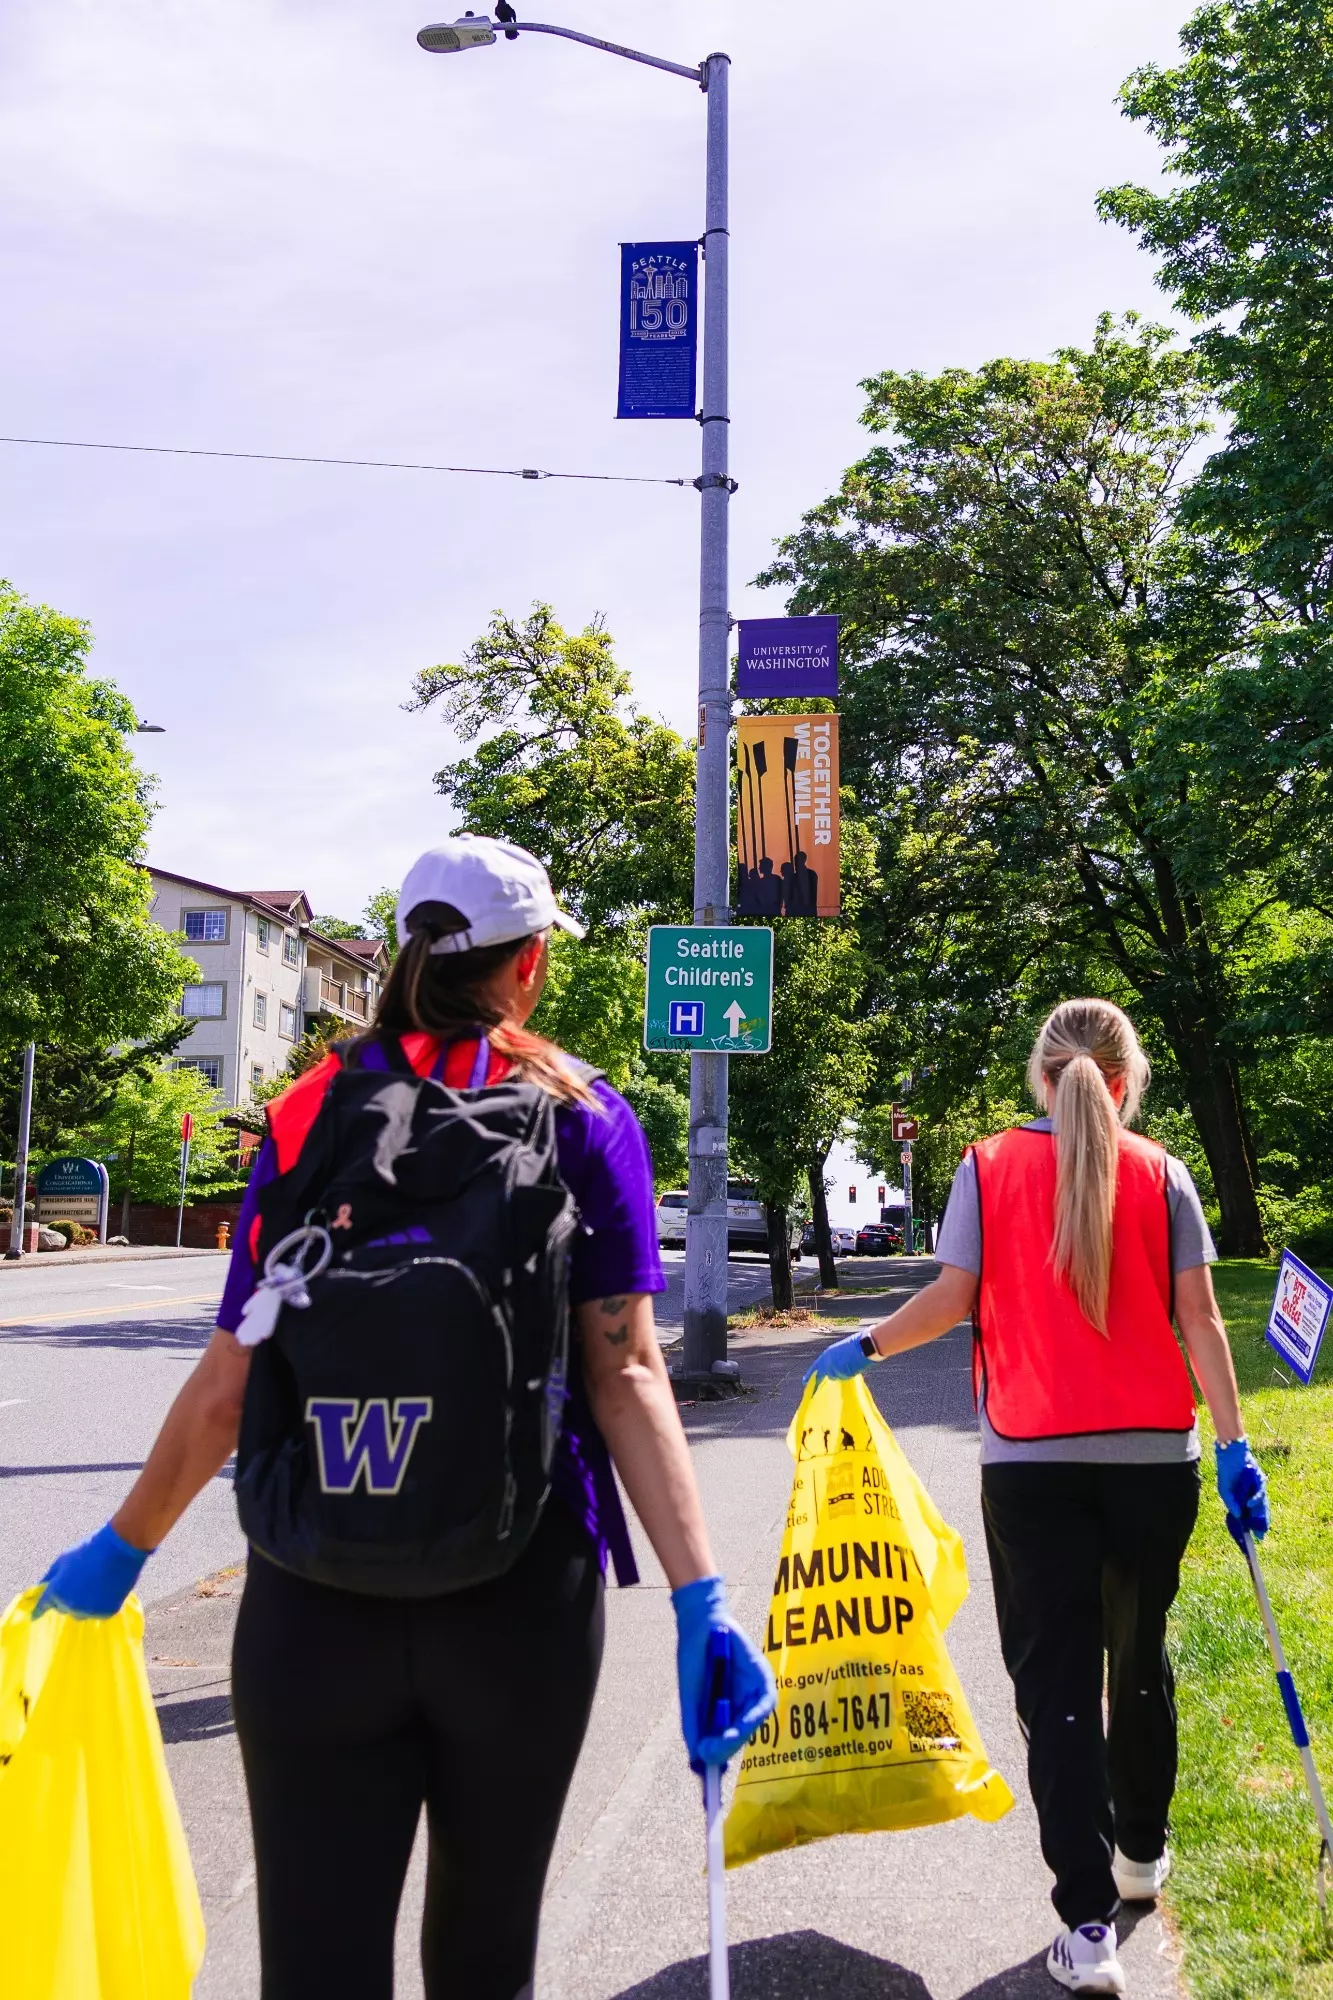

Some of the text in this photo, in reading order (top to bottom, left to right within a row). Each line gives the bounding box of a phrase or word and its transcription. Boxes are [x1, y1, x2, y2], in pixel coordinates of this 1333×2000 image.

[631, 255, 687, 271] SEATTLE
[630, 299, 687, 330] 150
[746, 656, 830, 670] WASHINGTON
[753, 645, 827, 656] UNIVERSITY of
[794, 722, 811, 826] WE WILL
[814, 721, 832, 846] TOGETHER
[677, 938, 744, 959] Seattle
[665, 966, 754, 987] Children's
[676, 1006, 697, 1032] H
[304, 1396, 433, 1495] W
[862, 1466, 891, 1492] ADO
[762, 1595, 914, 1653] LEANUP
[790, 1692, 890, 1740] 684-7647
